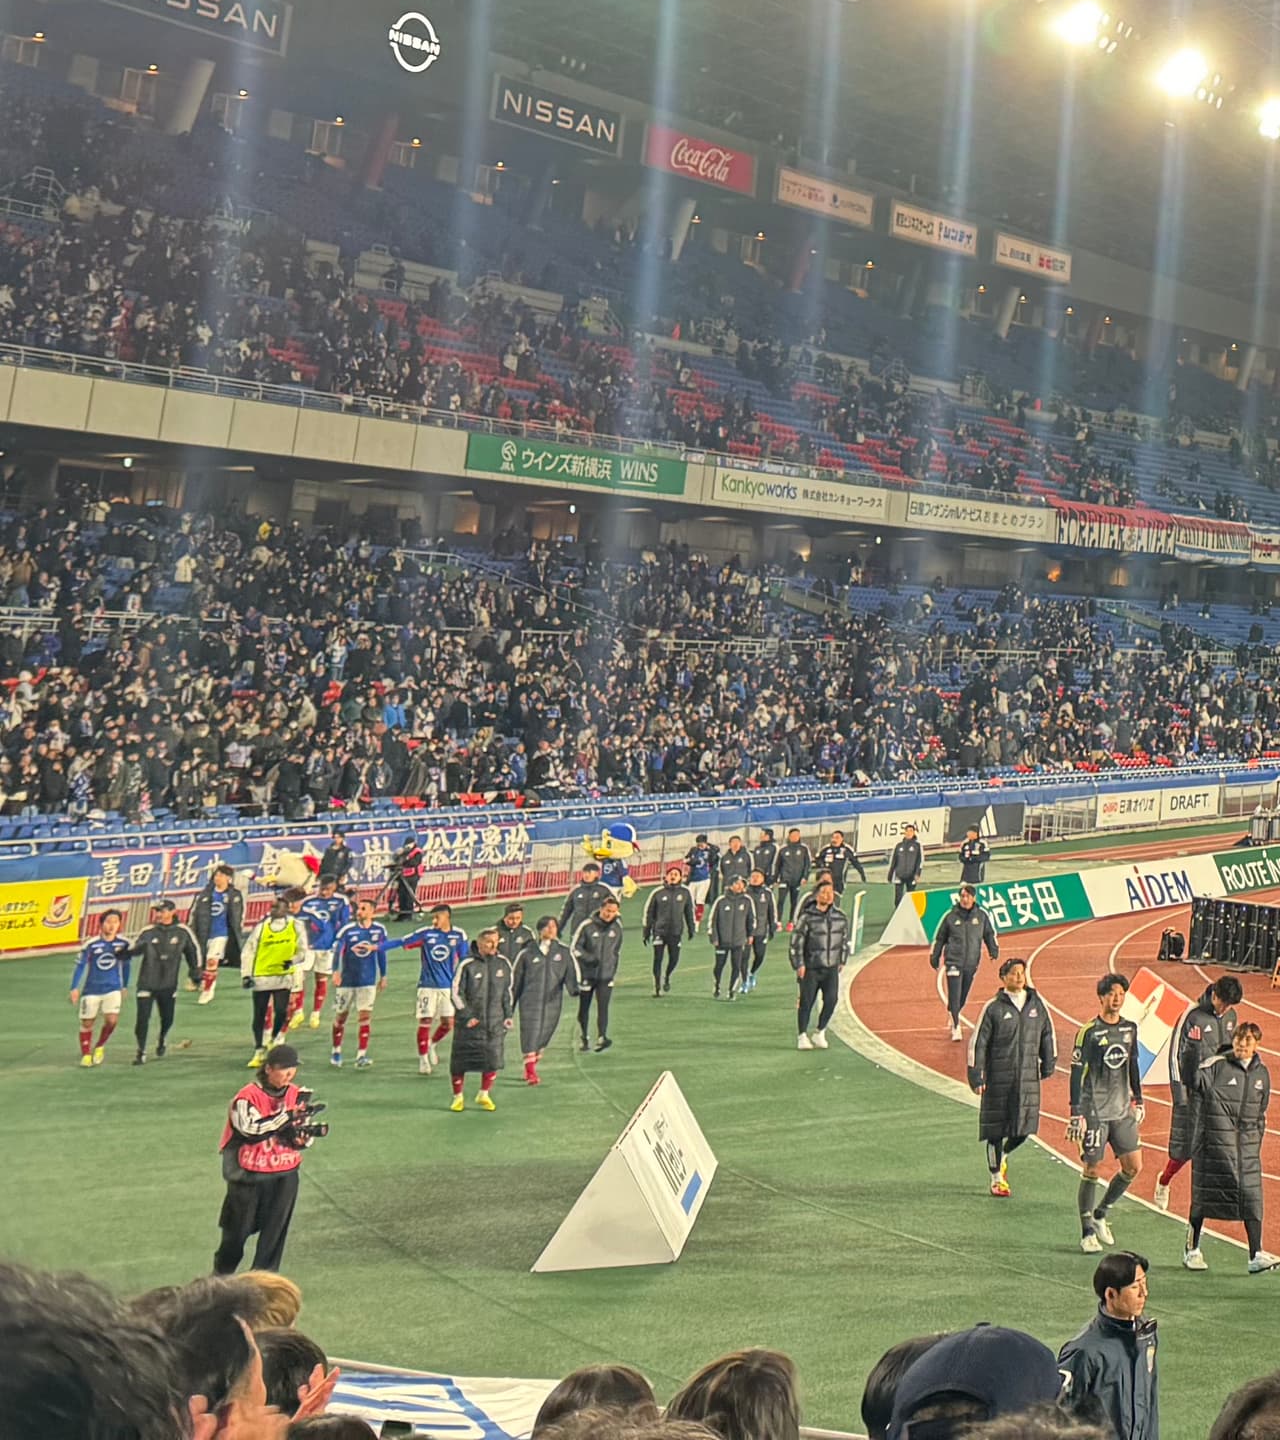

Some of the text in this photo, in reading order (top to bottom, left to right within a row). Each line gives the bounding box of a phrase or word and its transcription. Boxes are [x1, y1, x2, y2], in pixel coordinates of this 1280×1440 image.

[388, 28, 441, 57] NISSAN
[502, 89, 616, 143] NISSAN
[521, 449, 659, 482] ウインズ新横浜 WINS
[721, 473, 798, 500] Kankyoworks
[1222, 858, 1268, 891] ROUTE
[950, 880, 1065, 929] 治安田
[1085, 1129, 1101, 1148] 31
